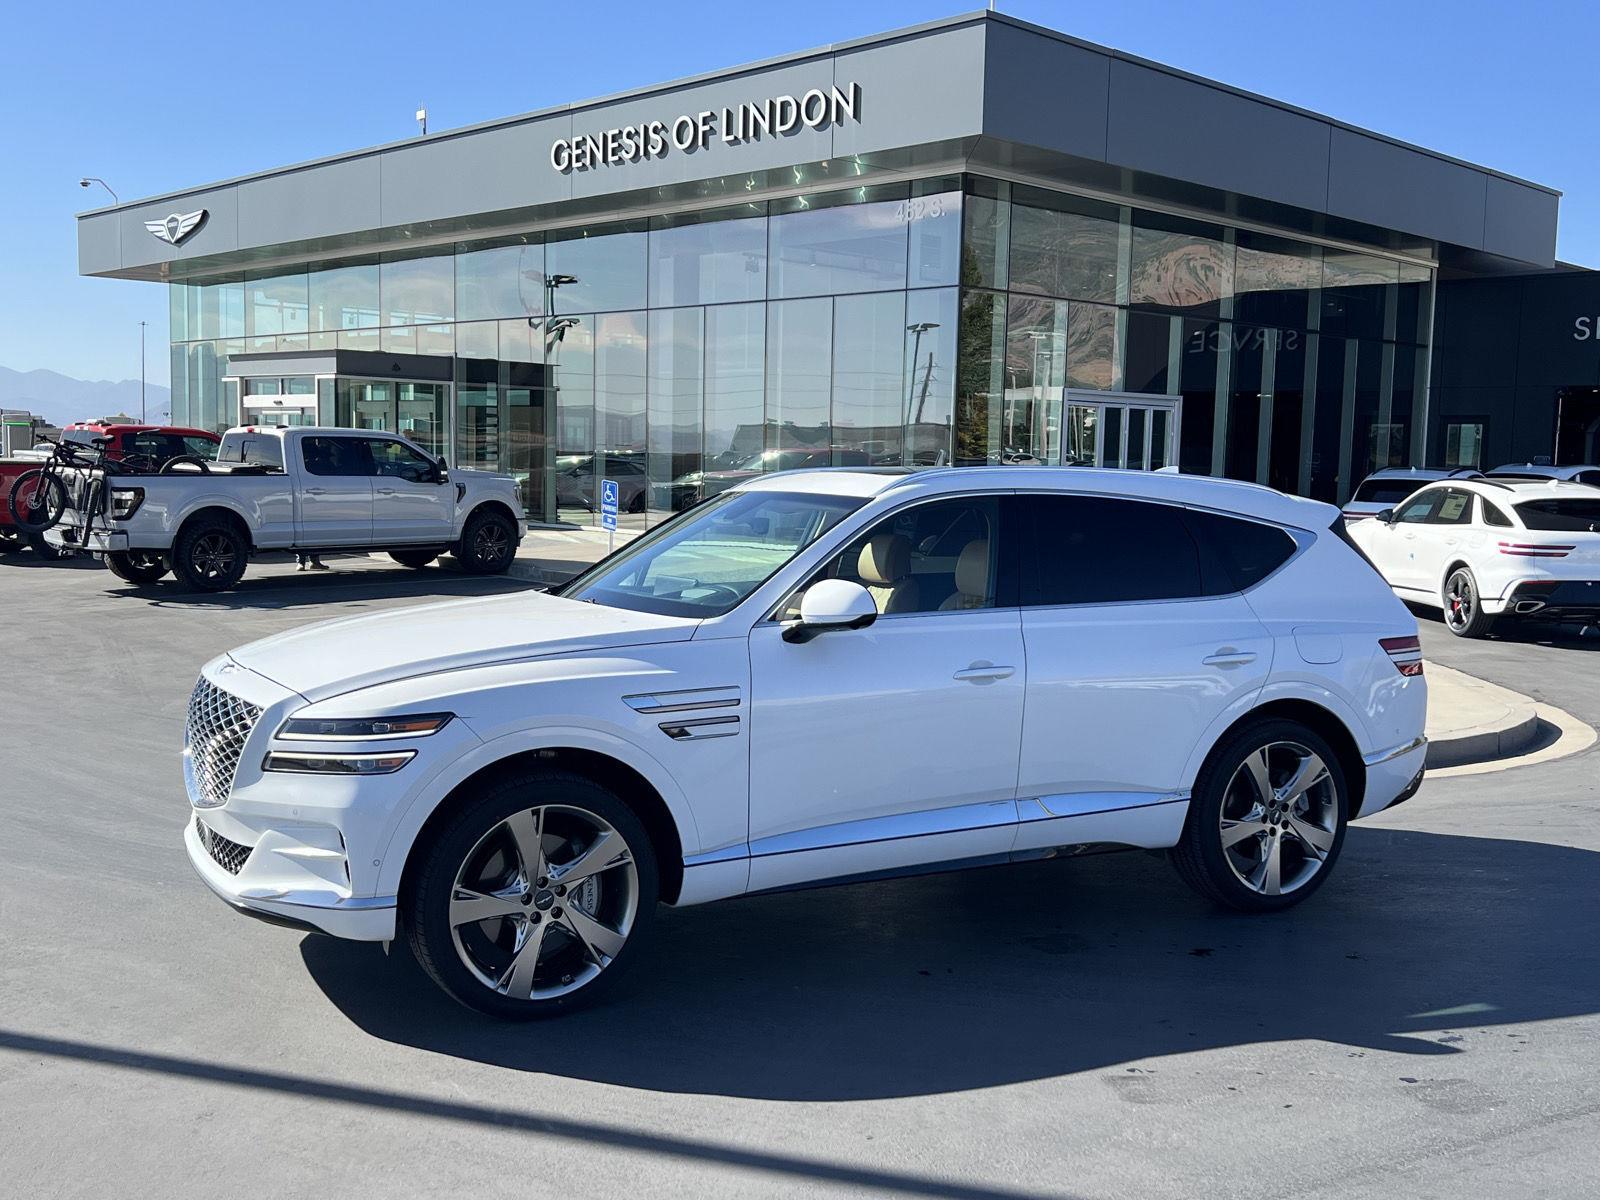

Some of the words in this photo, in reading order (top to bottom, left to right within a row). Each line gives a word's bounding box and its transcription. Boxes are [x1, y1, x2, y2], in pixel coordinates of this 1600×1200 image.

[550, 120, 665, 172] GENESIS
[672, 111, 713, 150] OF
[722, 82, 858, 142] LINDON
